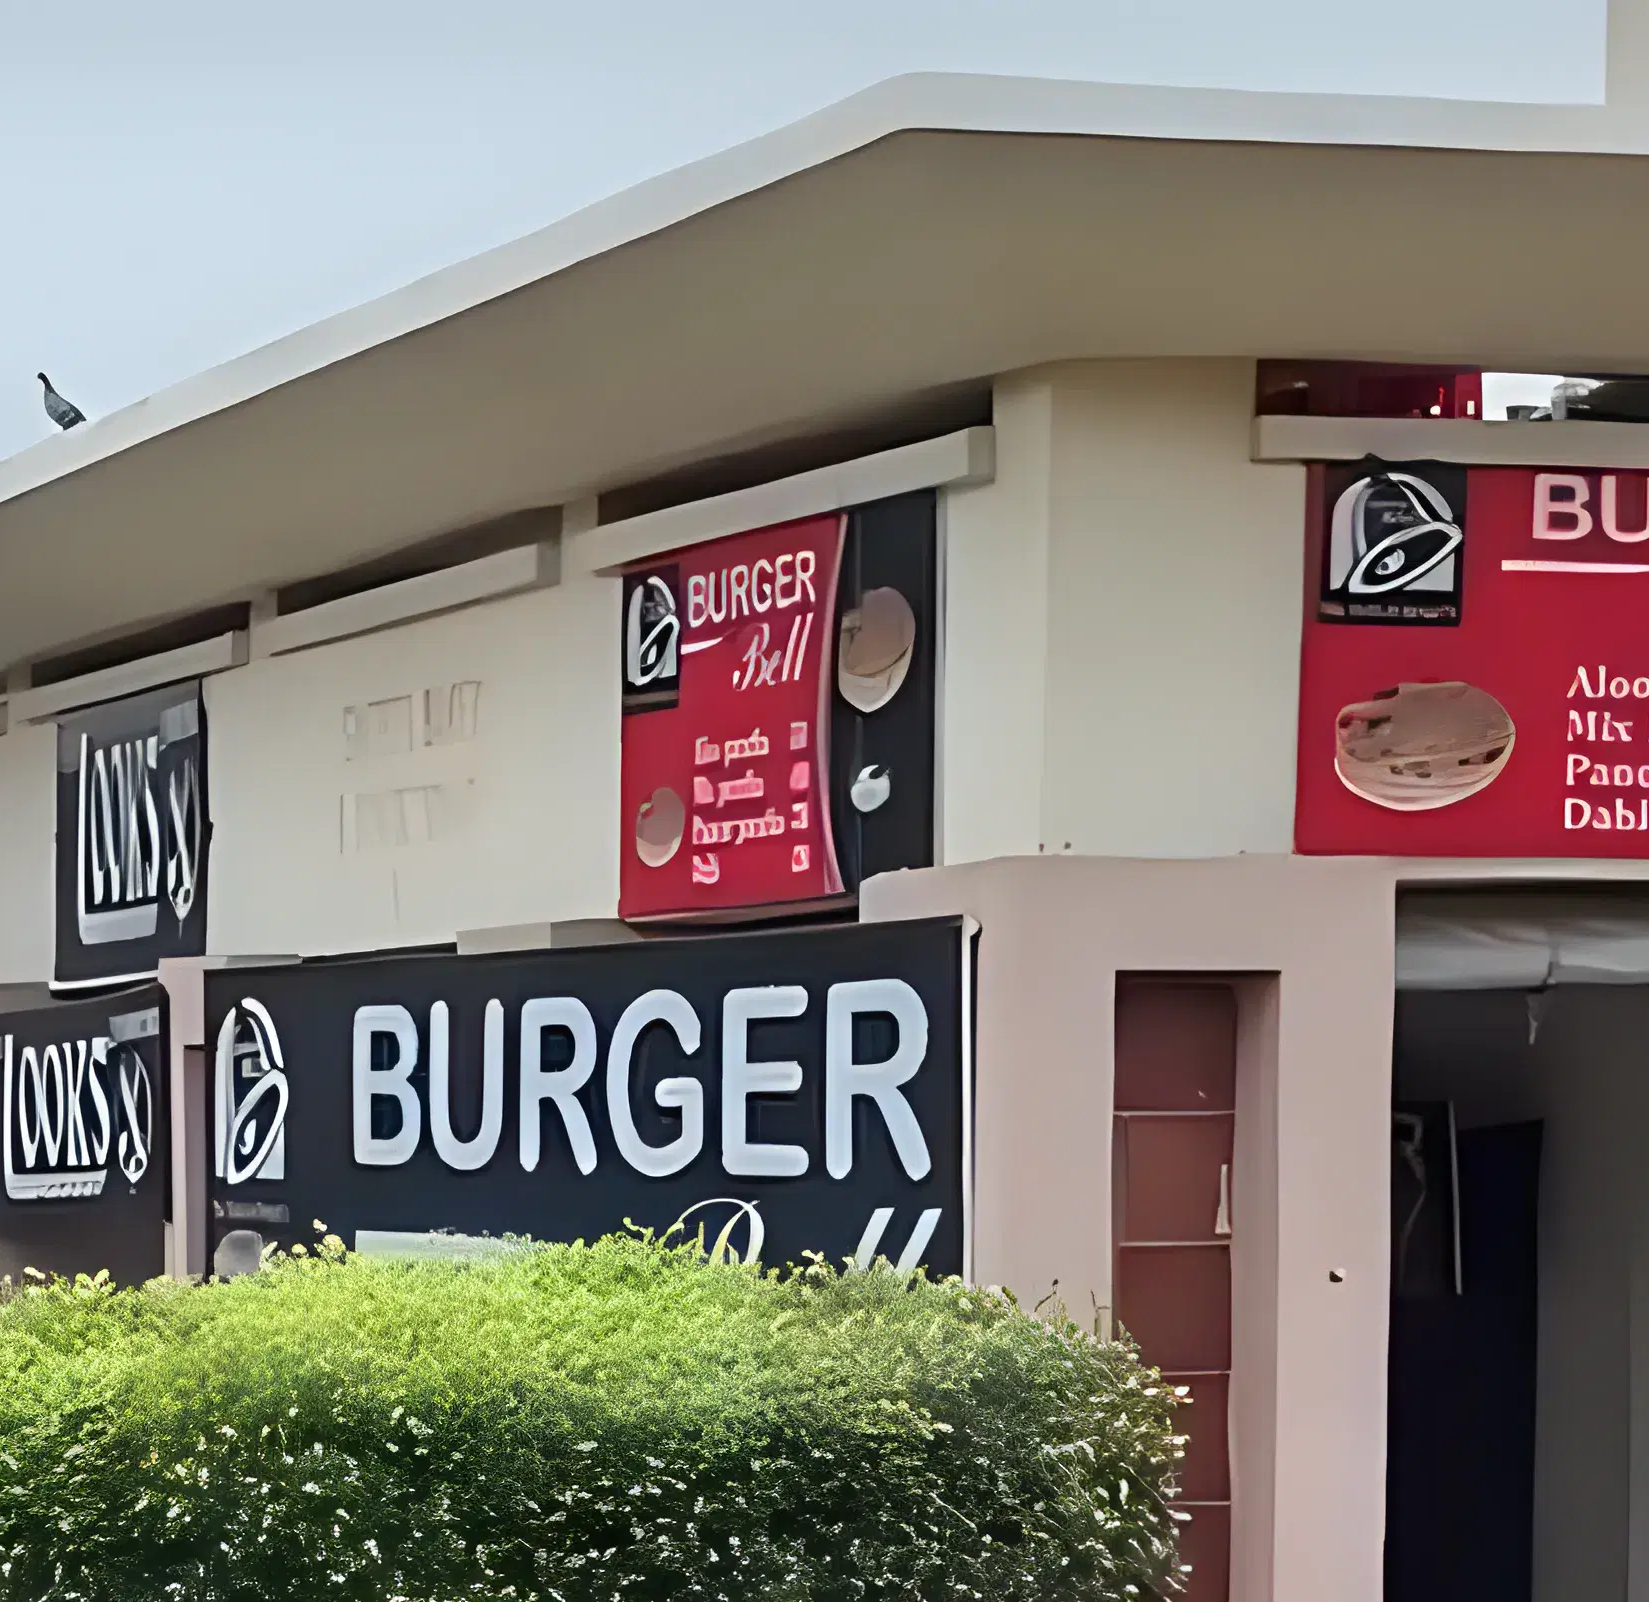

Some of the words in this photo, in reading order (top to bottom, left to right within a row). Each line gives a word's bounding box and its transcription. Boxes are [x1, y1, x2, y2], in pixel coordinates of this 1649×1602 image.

[687, 550, 816, 629] BURGER
[733, 612, 814, 691] Bell
[3, 1034, 112, 1200] LOOKS
[352, 978, 932, 1182] BURGER
